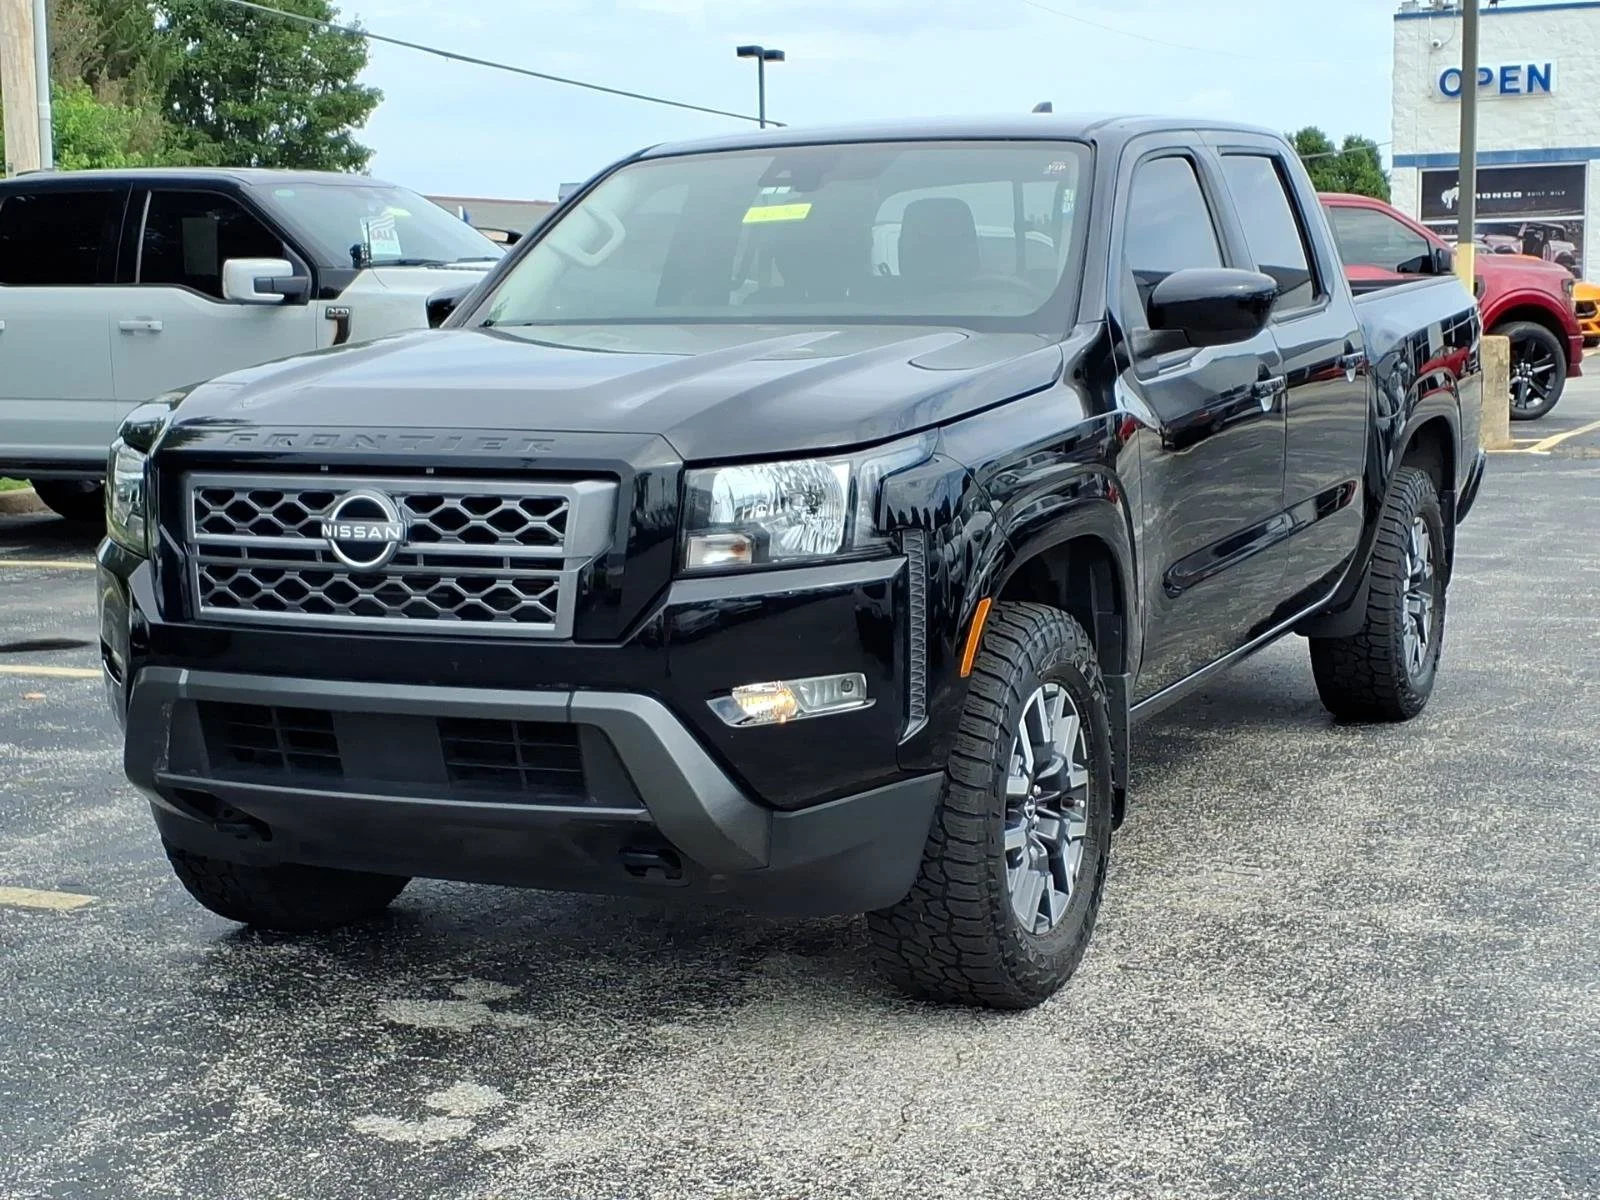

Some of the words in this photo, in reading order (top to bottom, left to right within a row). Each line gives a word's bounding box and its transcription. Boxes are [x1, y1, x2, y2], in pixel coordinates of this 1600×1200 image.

[1439, 63, 1552, 97] OPEN
[223, 432, 557, 454] FRONTIER
[322, 523, 401, 541] NISSAN
